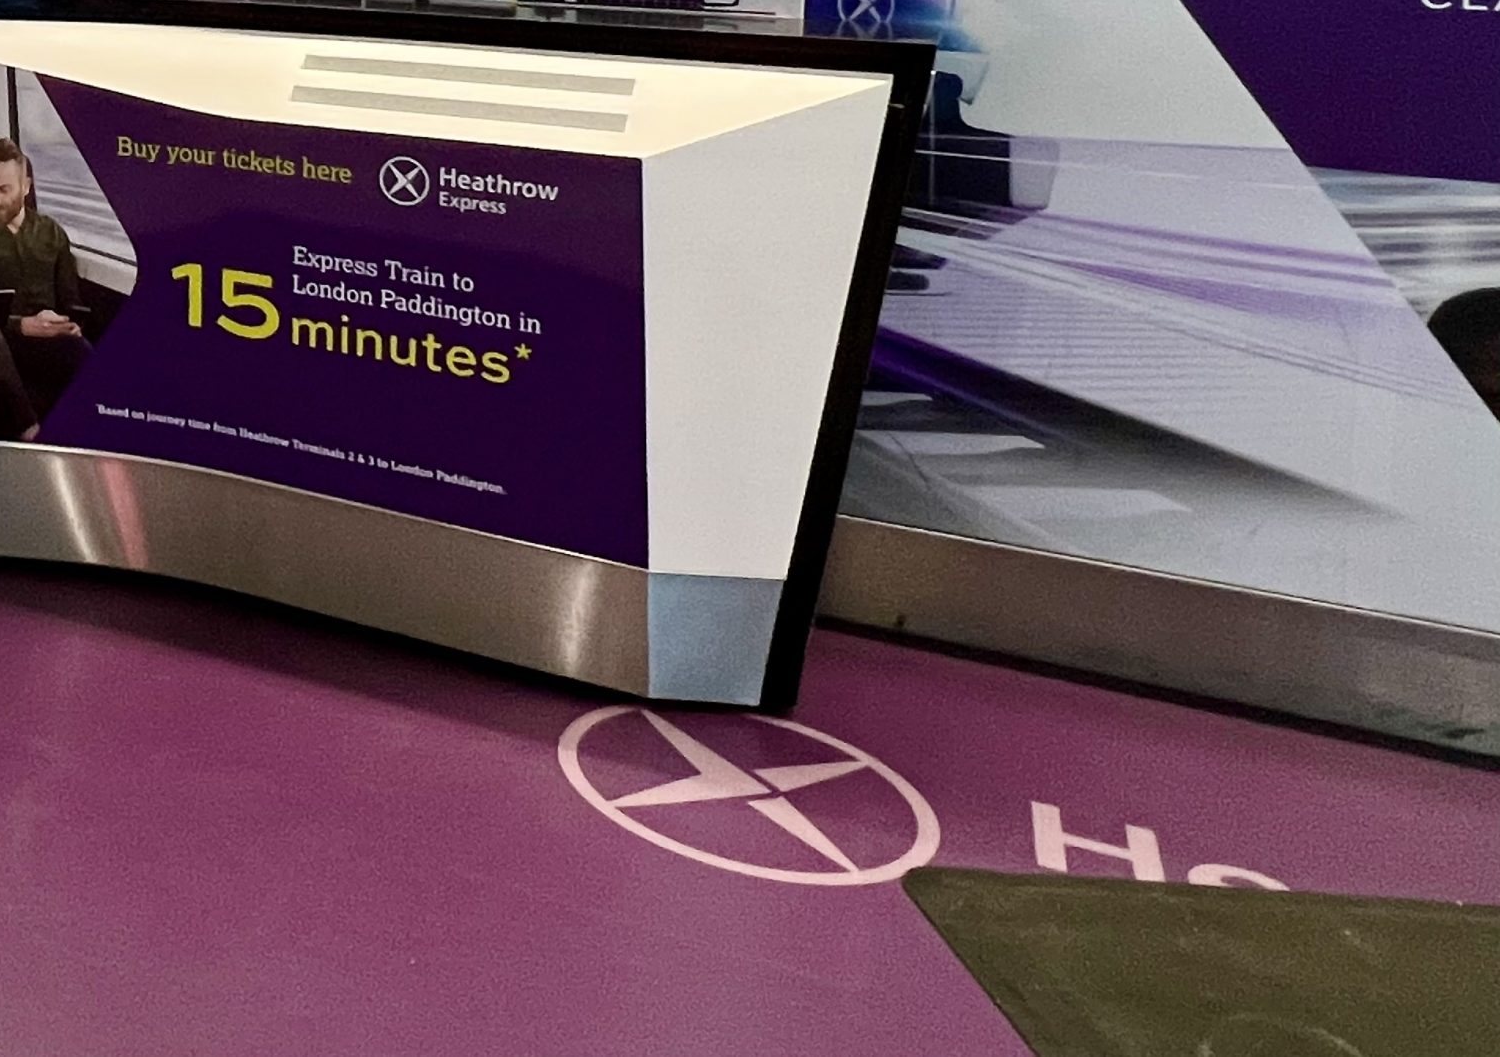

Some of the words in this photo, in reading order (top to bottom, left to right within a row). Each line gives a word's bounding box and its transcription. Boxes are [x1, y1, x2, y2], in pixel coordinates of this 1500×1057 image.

[117, 137, 159, 161] Buy
[167, 145, 216, 167] your
[223, 146, 294, 176] tickets
[302, 159, 352, 183] here
[439, 191, 506, 215] Express
[440, 167, 559, 201] Heathrow
[292, 246, 378, 277] Express
[386, 260, 445, 289] Train
[452, 272, 474, 292] to
[172, 262, 280, 340] 15
[292, 275, 373, 306] London
[380, 289, 511, 331] Paddington
[519, 312, 541, 334] in
